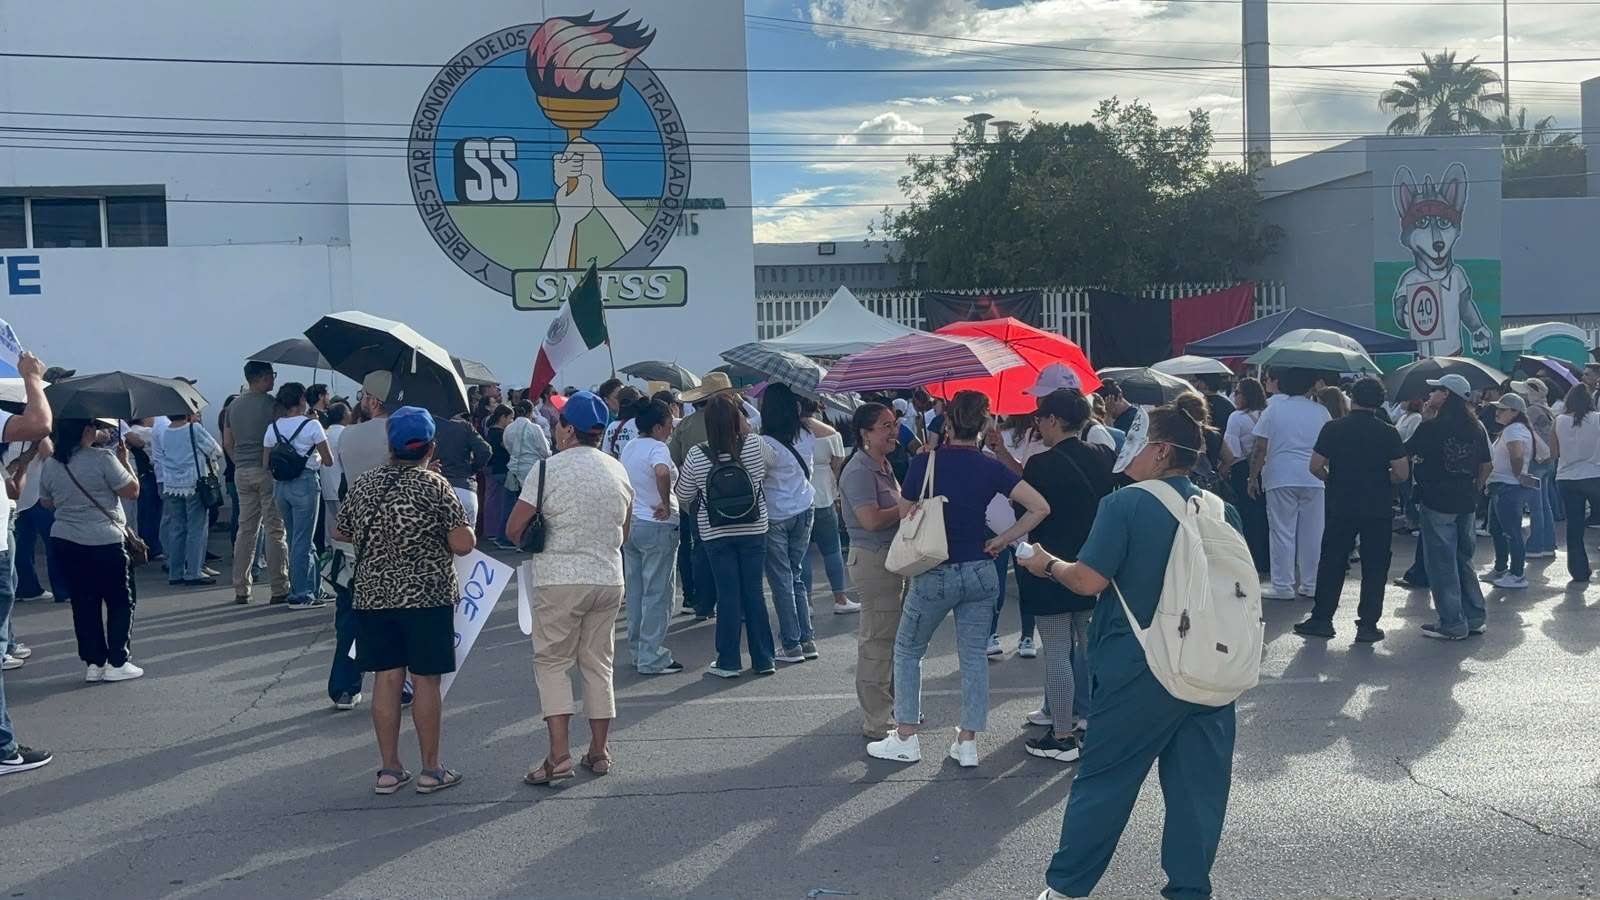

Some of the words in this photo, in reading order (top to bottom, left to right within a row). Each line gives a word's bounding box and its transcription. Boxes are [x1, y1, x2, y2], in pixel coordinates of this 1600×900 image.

[475, 39, 499, 61] DE
[500, 29, 528, 51] LOS
[415, 55, 474, 141] ECONOMICO
[454, 136, 520, 202] SS
[412, 149, 471, 261] BIENESTAR
[0, 255, 42, 295] E
[474, 263, 490, 281] Y
[1416, 297, 1433, 317] 40
[455, 559, 495, 623] ZOE
